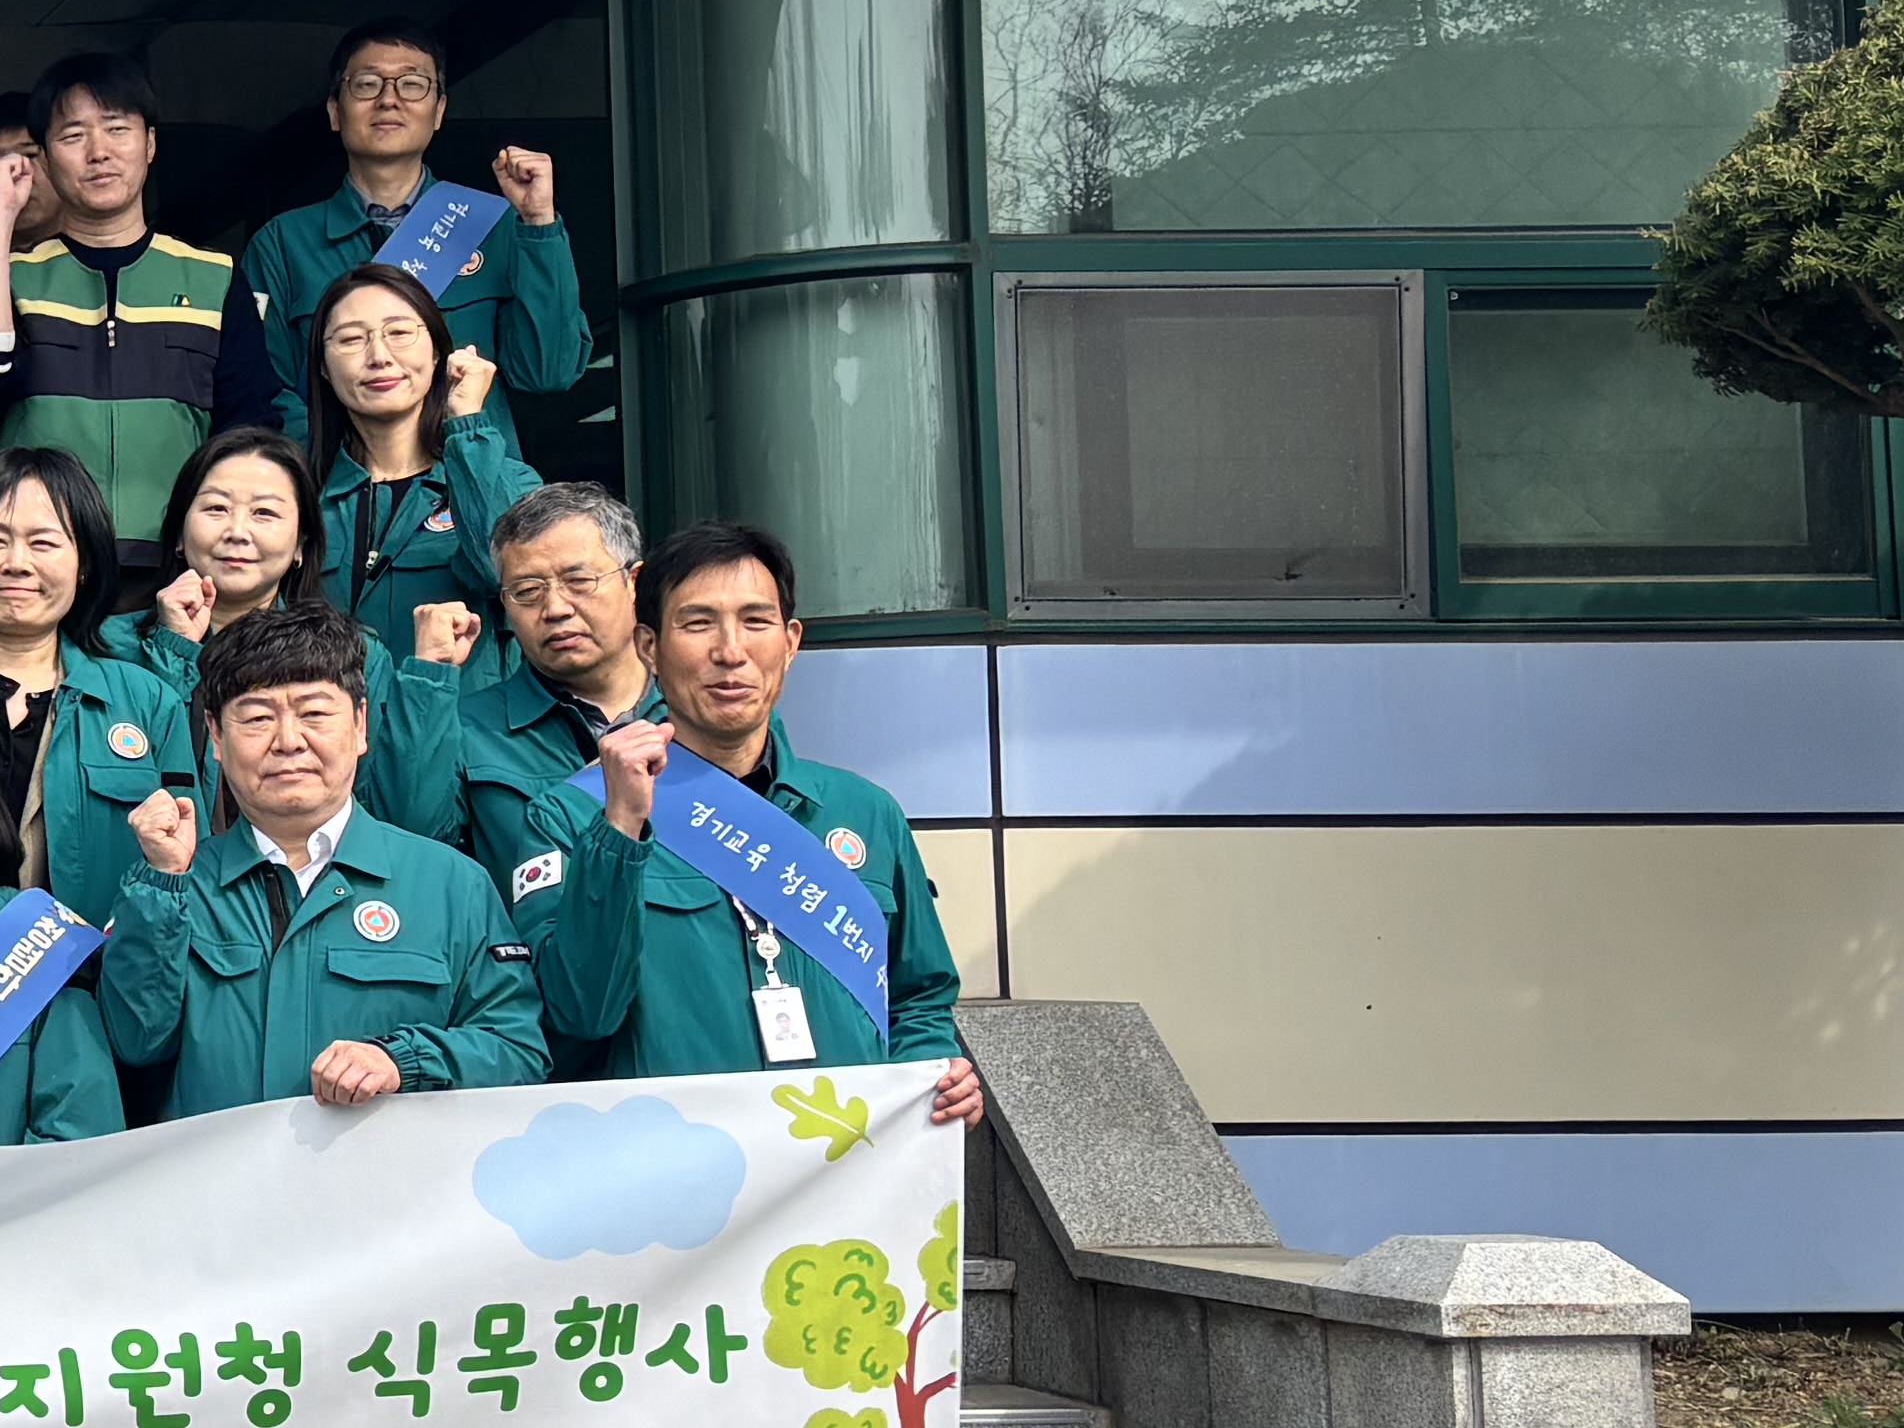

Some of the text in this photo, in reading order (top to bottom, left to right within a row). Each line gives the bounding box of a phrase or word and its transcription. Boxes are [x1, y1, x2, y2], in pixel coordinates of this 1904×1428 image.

[690, 801, 771, 872] 경기교육
[780, 861, 828, 915] 청렴
[823, 903, 874, 964] 1번지
[349, 1297, 748, 1418] 식목행사
